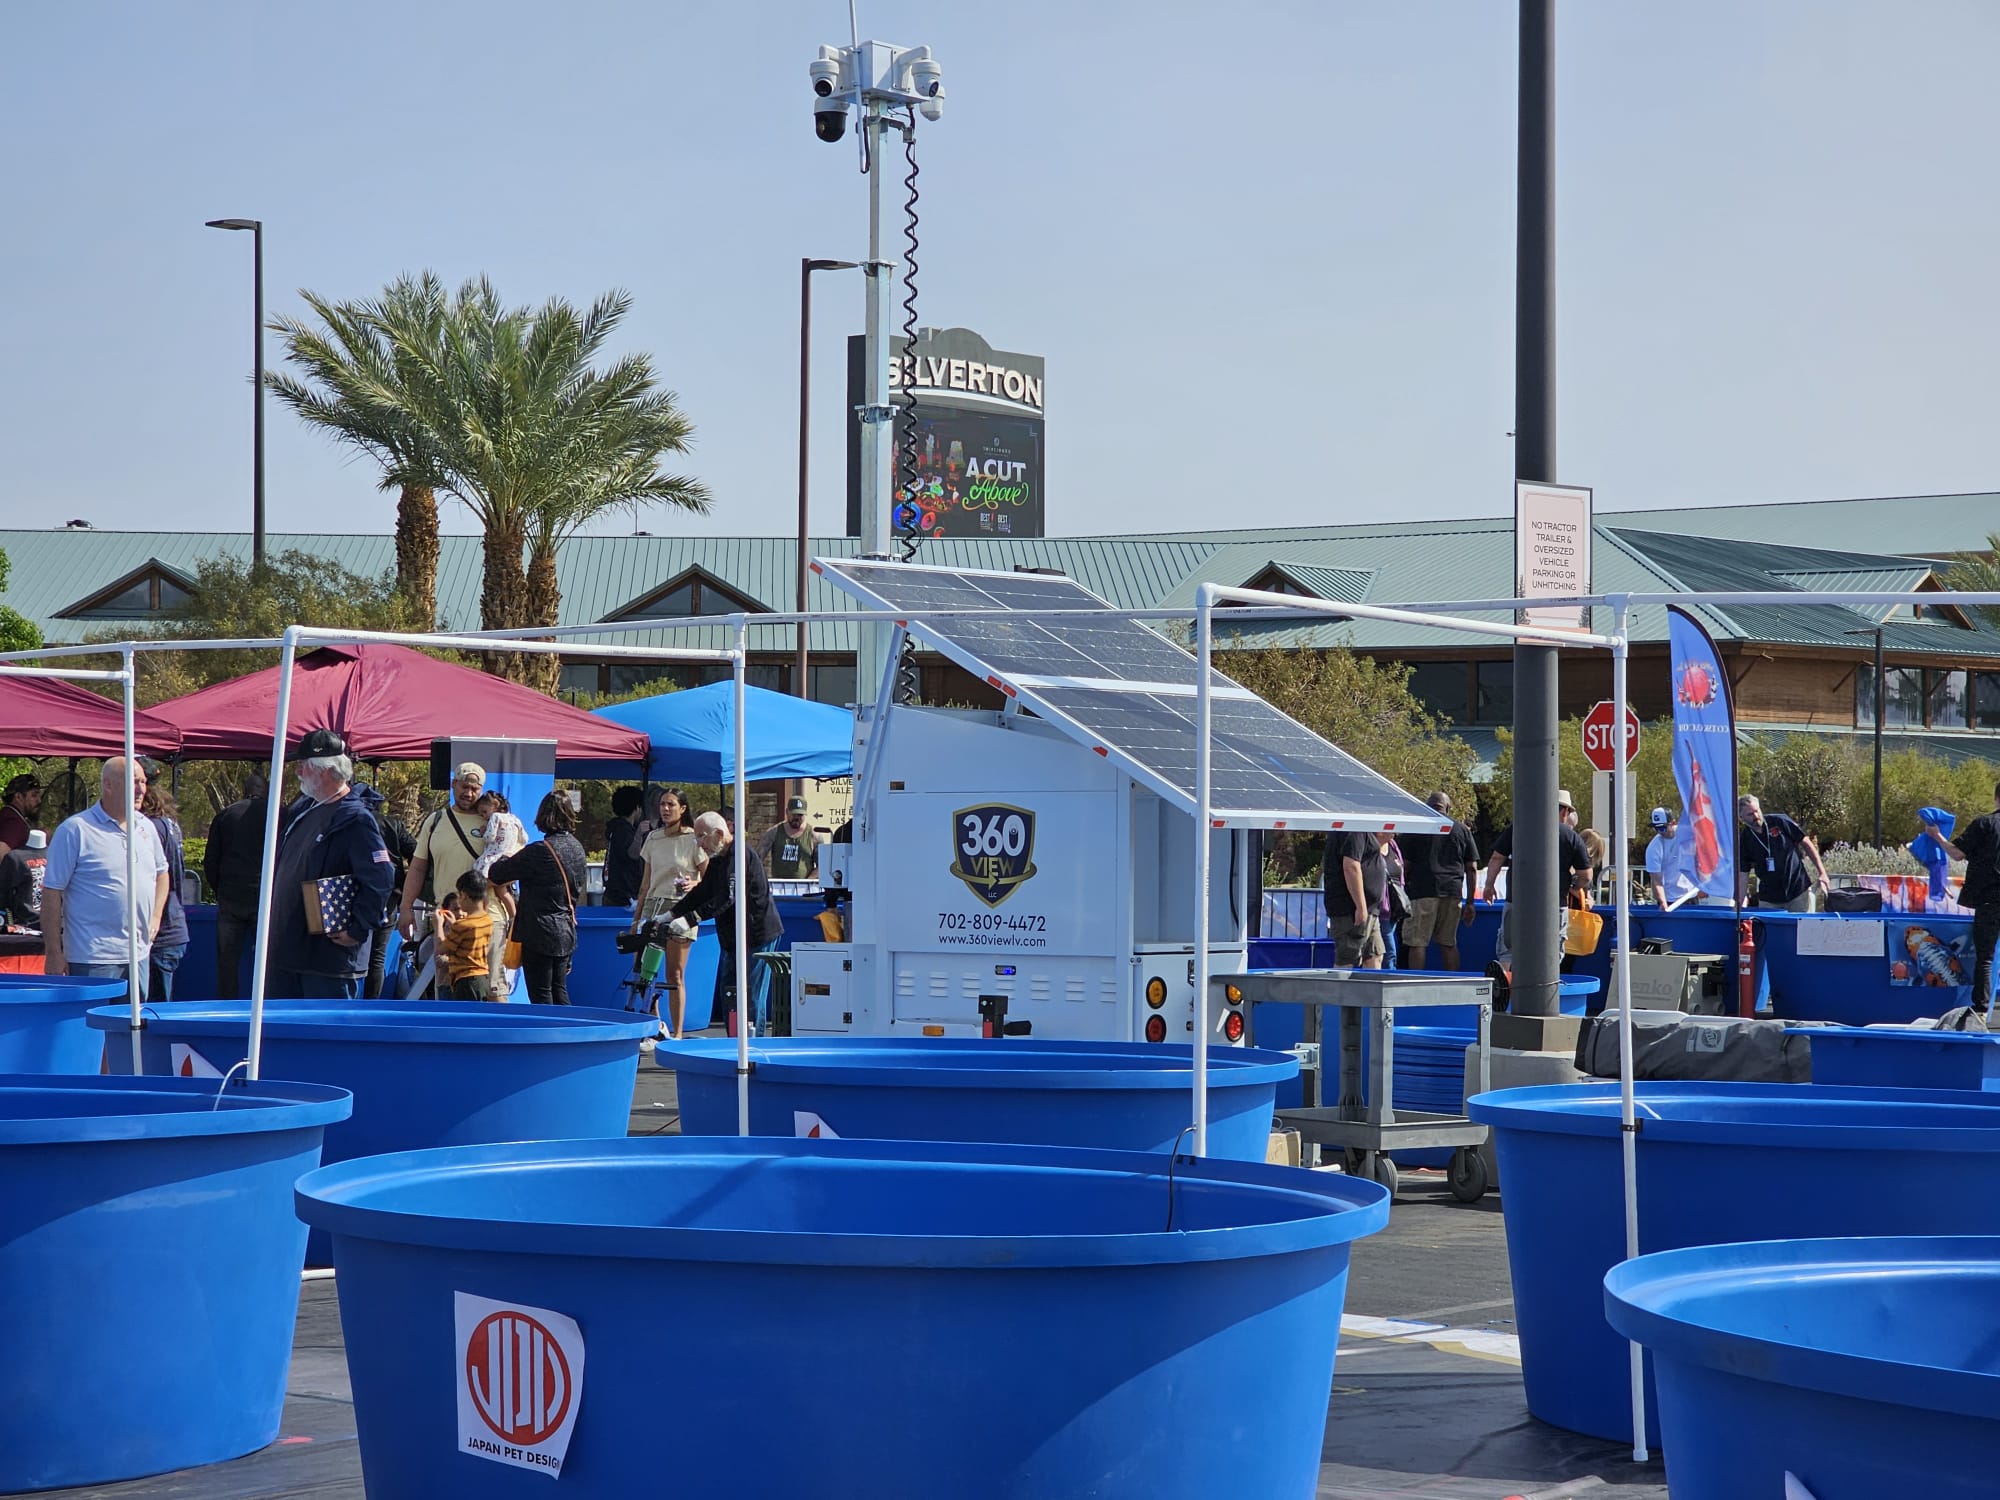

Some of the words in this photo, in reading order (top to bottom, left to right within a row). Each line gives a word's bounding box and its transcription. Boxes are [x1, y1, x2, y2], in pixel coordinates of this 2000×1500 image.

[888, 356, 1042, 408] SILVERTON
[966, 457, 979, 478] A
[983, 459, 1026, 483] CUT
[962, 474, 1029, 510] Above
[1531, 521, 1542, 530] NO
[1544, 522, 1577, 532] TRACTOR
[1536, 533, 1566, 543] TRAILER
[1567, 535, 1572, 544] &
[1534, 545, 1574, 556] OVERSIZED
[1539, 557, 1569, 567] VEHICLE
[1532, 569, 1564, 579] PARKING
[1565, 571, 1576, 579] OR
[1532, 581, 1576, 591] UNHITCHING
[830, 778, 854, 786] SILVE
[829, 808, 846, 816] THE
[961, 814, 1026, 857] 360
[969, 856, 1015, 877] VIEW
[938, 913, 1046, 931] 702-809-4472
[938, 934, 1046, 948] www.360viewlv.com
[467, 1436, 501, 1455] JAPAN
[503, 1446, 523, 1461] PET
